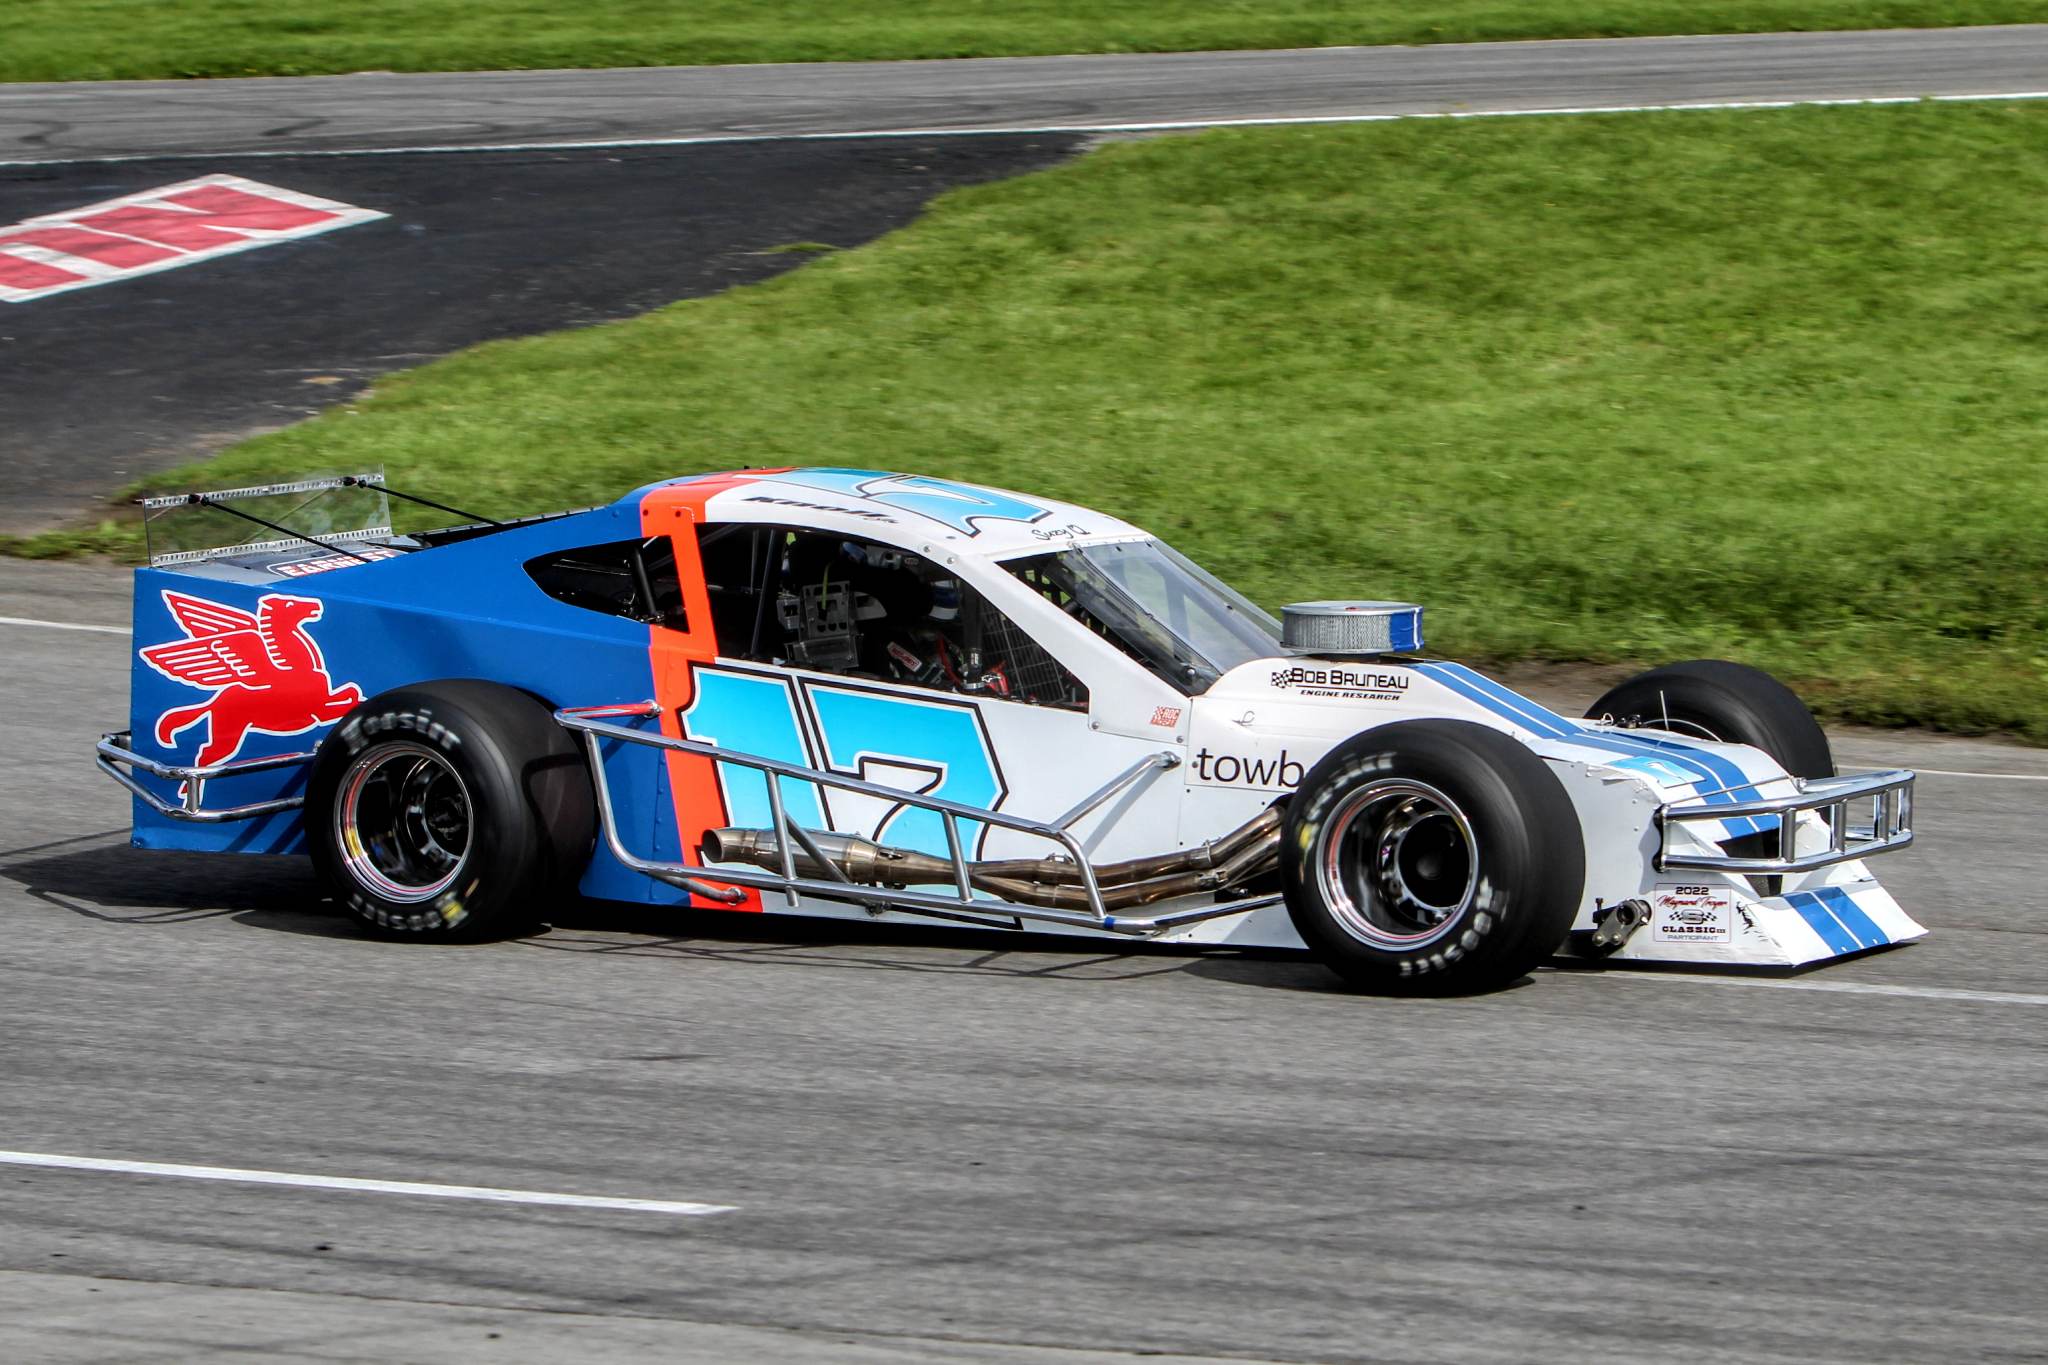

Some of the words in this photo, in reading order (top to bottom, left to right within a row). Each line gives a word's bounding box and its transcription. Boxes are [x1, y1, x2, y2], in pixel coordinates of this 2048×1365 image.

[1291, 667, 1328, 684] BOB
[1300, 690, 1340, 698] ENGINE
[1341, 692, 1401, 701] RESEARCH
[681, 660, 1022, 929] 17
[1675, 886, 1710, 895] 2022
[1662, 926, 1716, 934] CLASSIC
